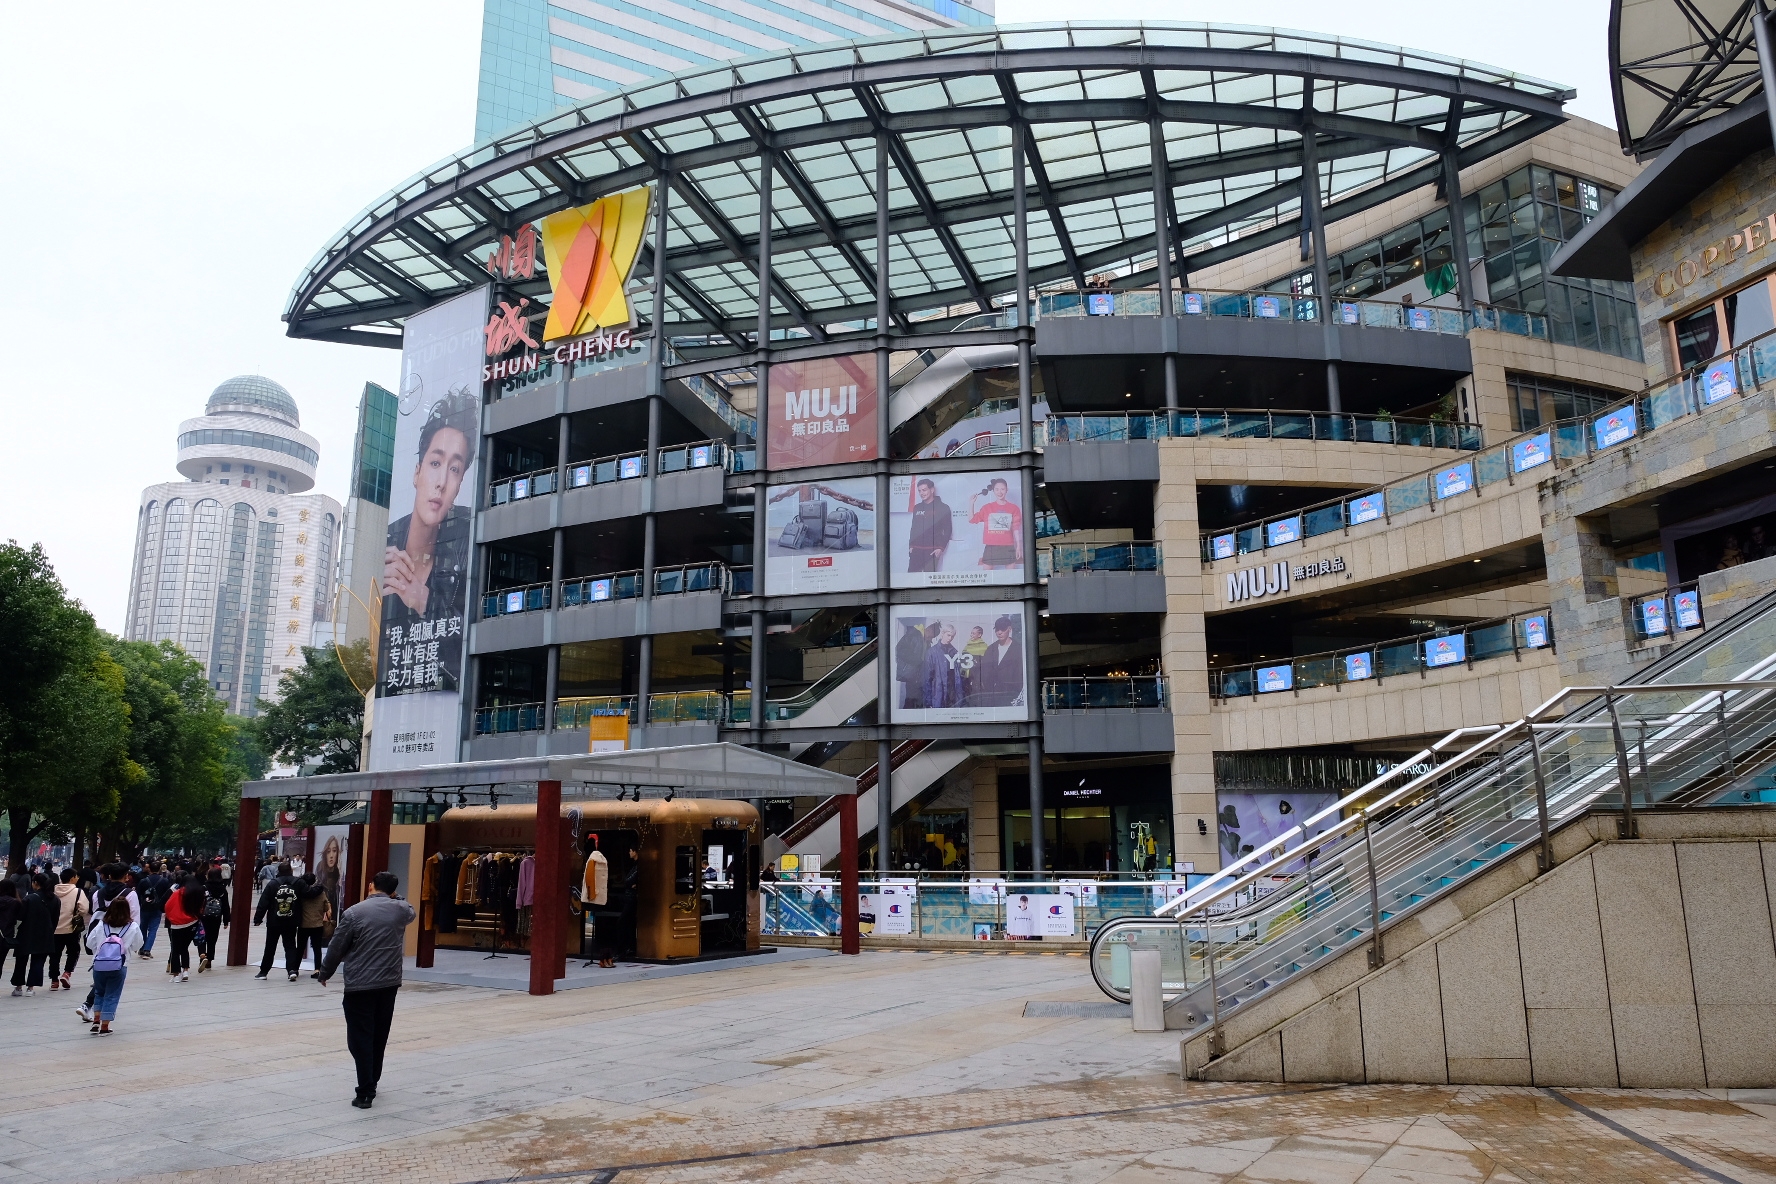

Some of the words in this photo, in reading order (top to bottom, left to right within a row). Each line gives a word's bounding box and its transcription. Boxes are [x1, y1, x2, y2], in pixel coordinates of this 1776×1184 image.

[461, 327, 484, 349] FIX
[482, 353, 540, 382] SHUN
[554, 329, 634, 364] CHENG
[785, 384, 857, 421] MUJI
[791, 418, 850, 437] 無印良品
[1226, 560, 1290, 603] MUJI
[1292, 556, 1346, 581] 無印良品
[389, 641, 440, 667] 专业有度
